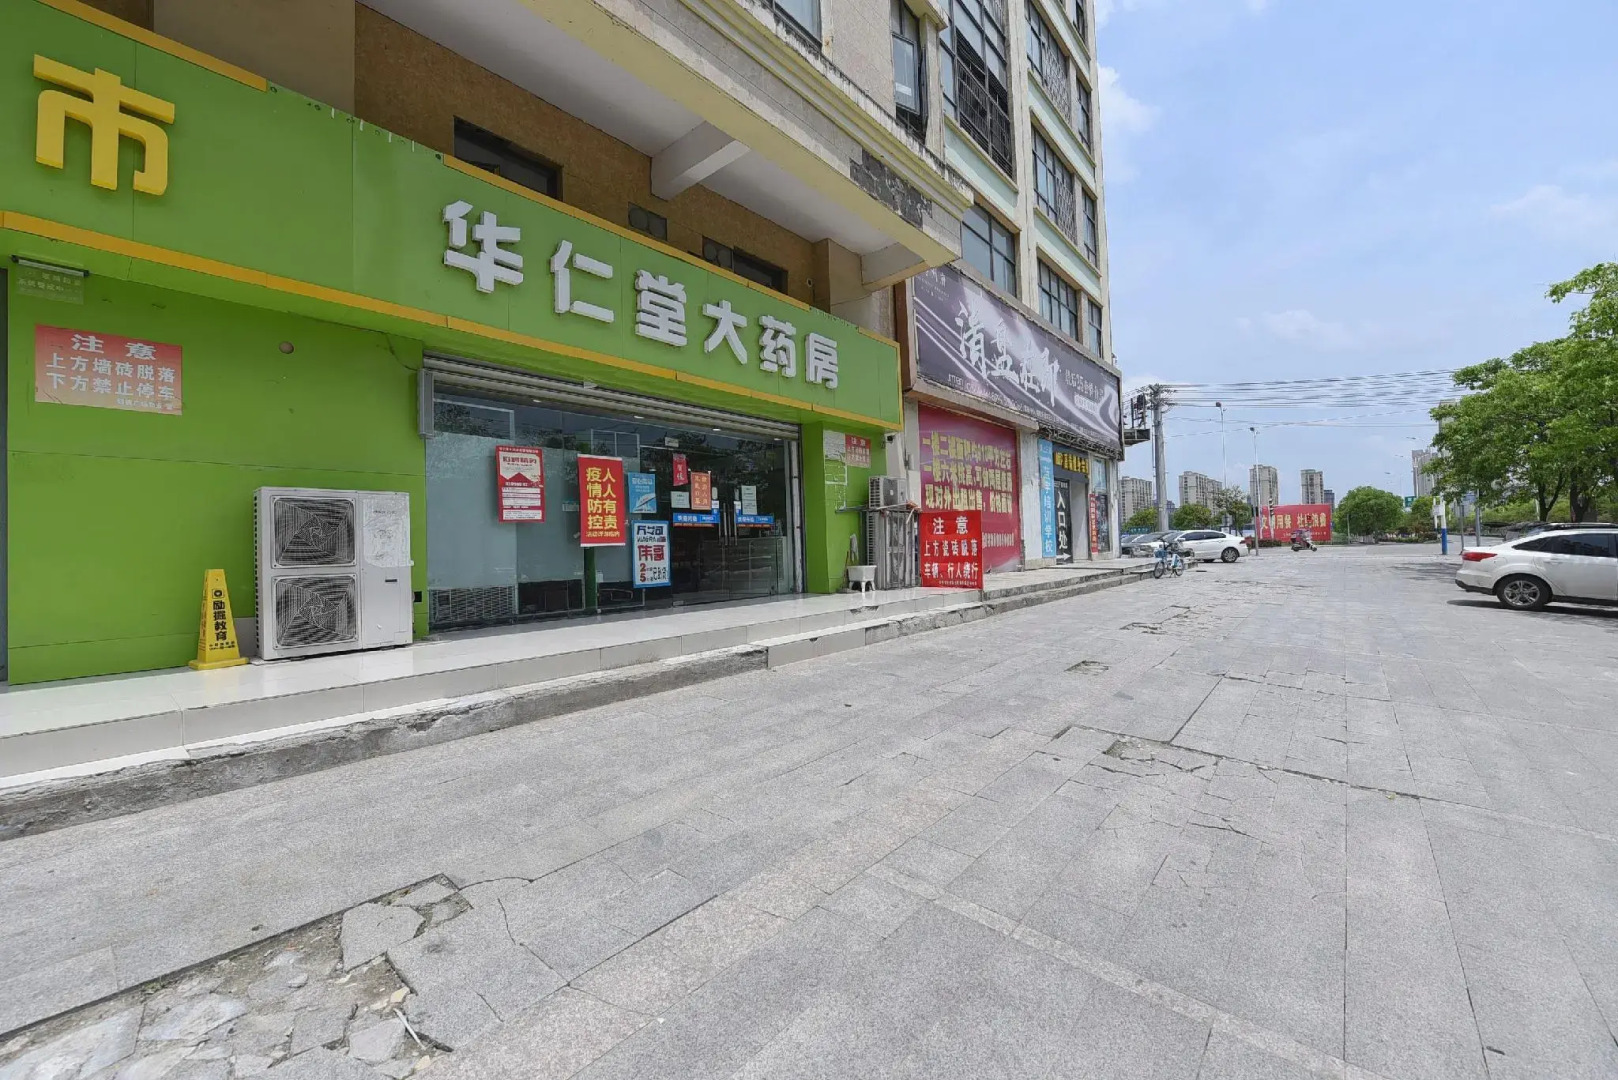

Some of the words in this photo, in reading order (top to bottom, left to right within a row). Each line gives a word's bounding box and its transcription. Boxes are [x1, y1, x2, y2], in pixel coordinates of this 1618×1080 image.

[34, 53, 175, 196] 市
[442, 200, 839, 389] 华仁堂大药房
[71, 334, 156, 360] 注意
[46, 352, 175, 383] 上方墙砖脱落
[46, 372, 175, 400] 下方禁止停车
[586, 466, 603, 530] 疫情防控
[602, 467, 618, 530] 人人有责
[932, 515, 968, 535] 注意
[1057, 490, 1068, 549] 入口处
[637, 544, 665, 561] 伟哥
[924, 538, 978, 557] 上方瓷砖脱落
[640, 563, 646, 572] 2
[640, 573, 646, 582] 5
[924, 561, 979, 580] 车辆、行人绕行
